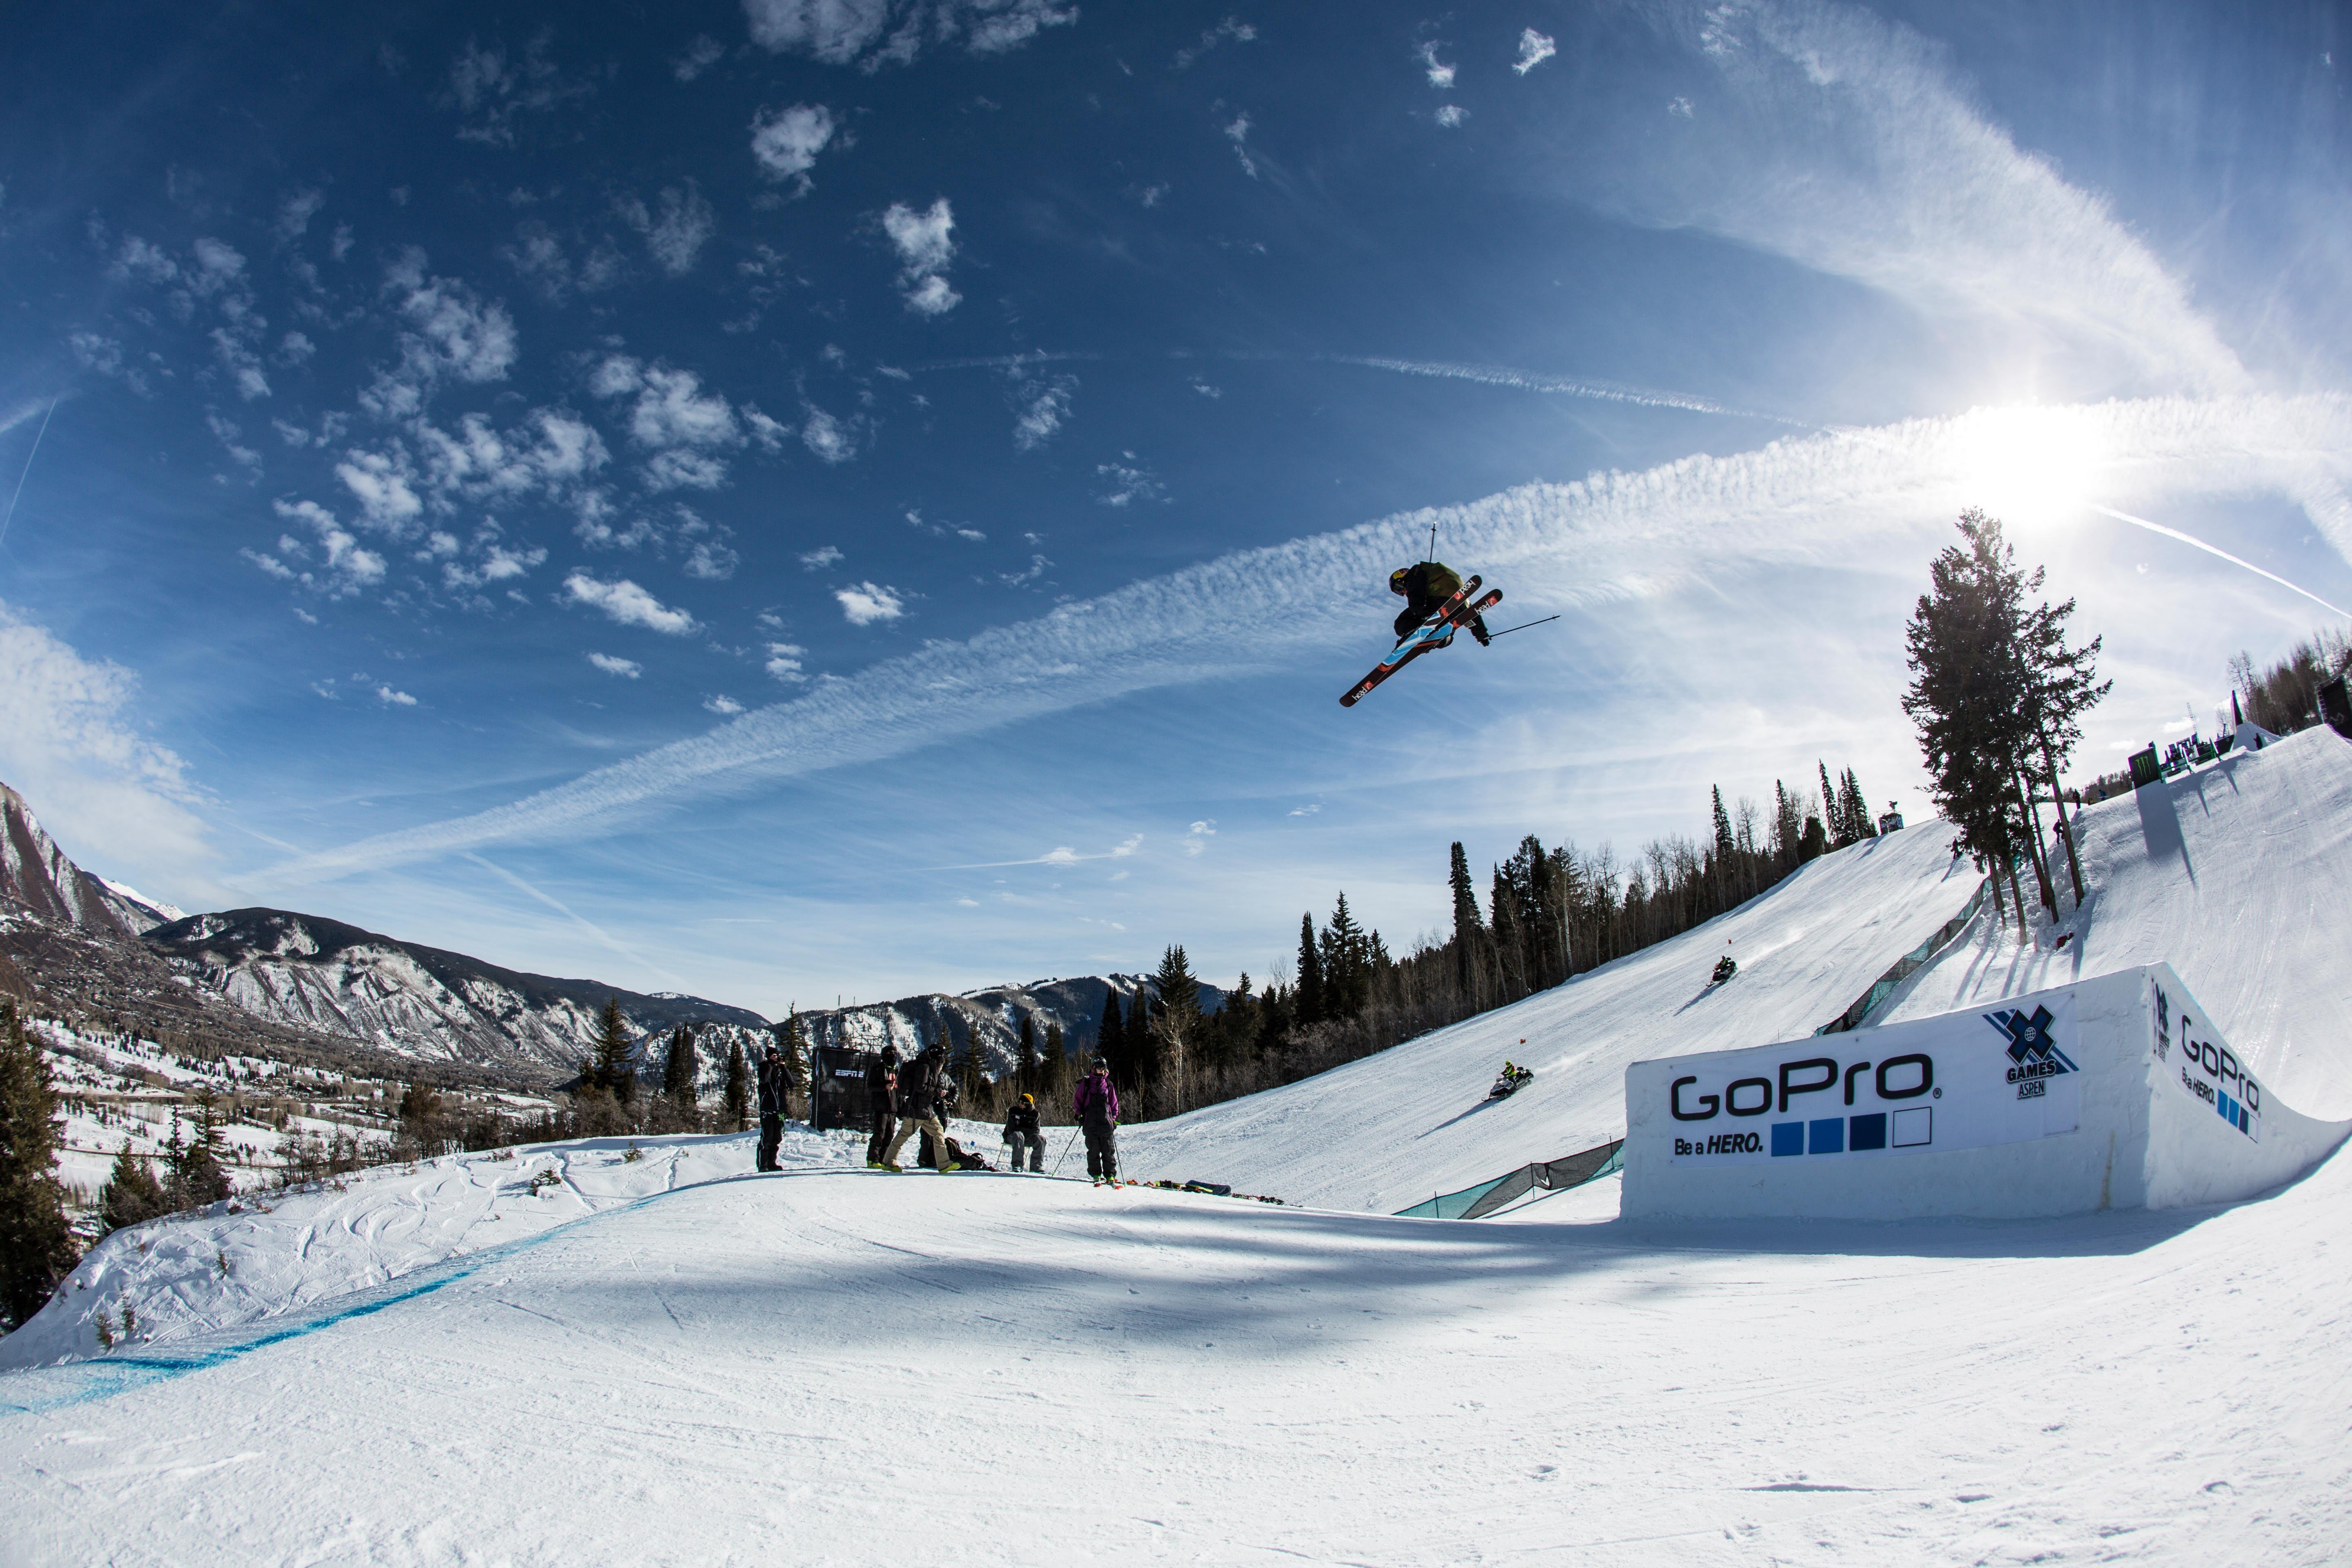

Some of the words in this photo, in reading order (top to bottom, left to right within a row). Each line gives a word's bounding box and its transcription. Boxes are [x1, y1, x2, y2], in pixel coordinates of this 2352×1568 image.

[1459, 579, 1476, 595] head
[1474, 601, 1490, 615] head
[1352, 686, 1368, 700] head
[2007, 1061, 2056, 1082] GAMES
[2018, 1080, 2044, 1097] ASPEN
[2187, 1078, 2192, 1090] a
[2193, 1077, 2215, 1106] HERO.
[1675, 1138, 1692, 1155] Be
[1695, 1142, 1703, 1154] a
[1707, 1132, 1763, 1154] HERO.
